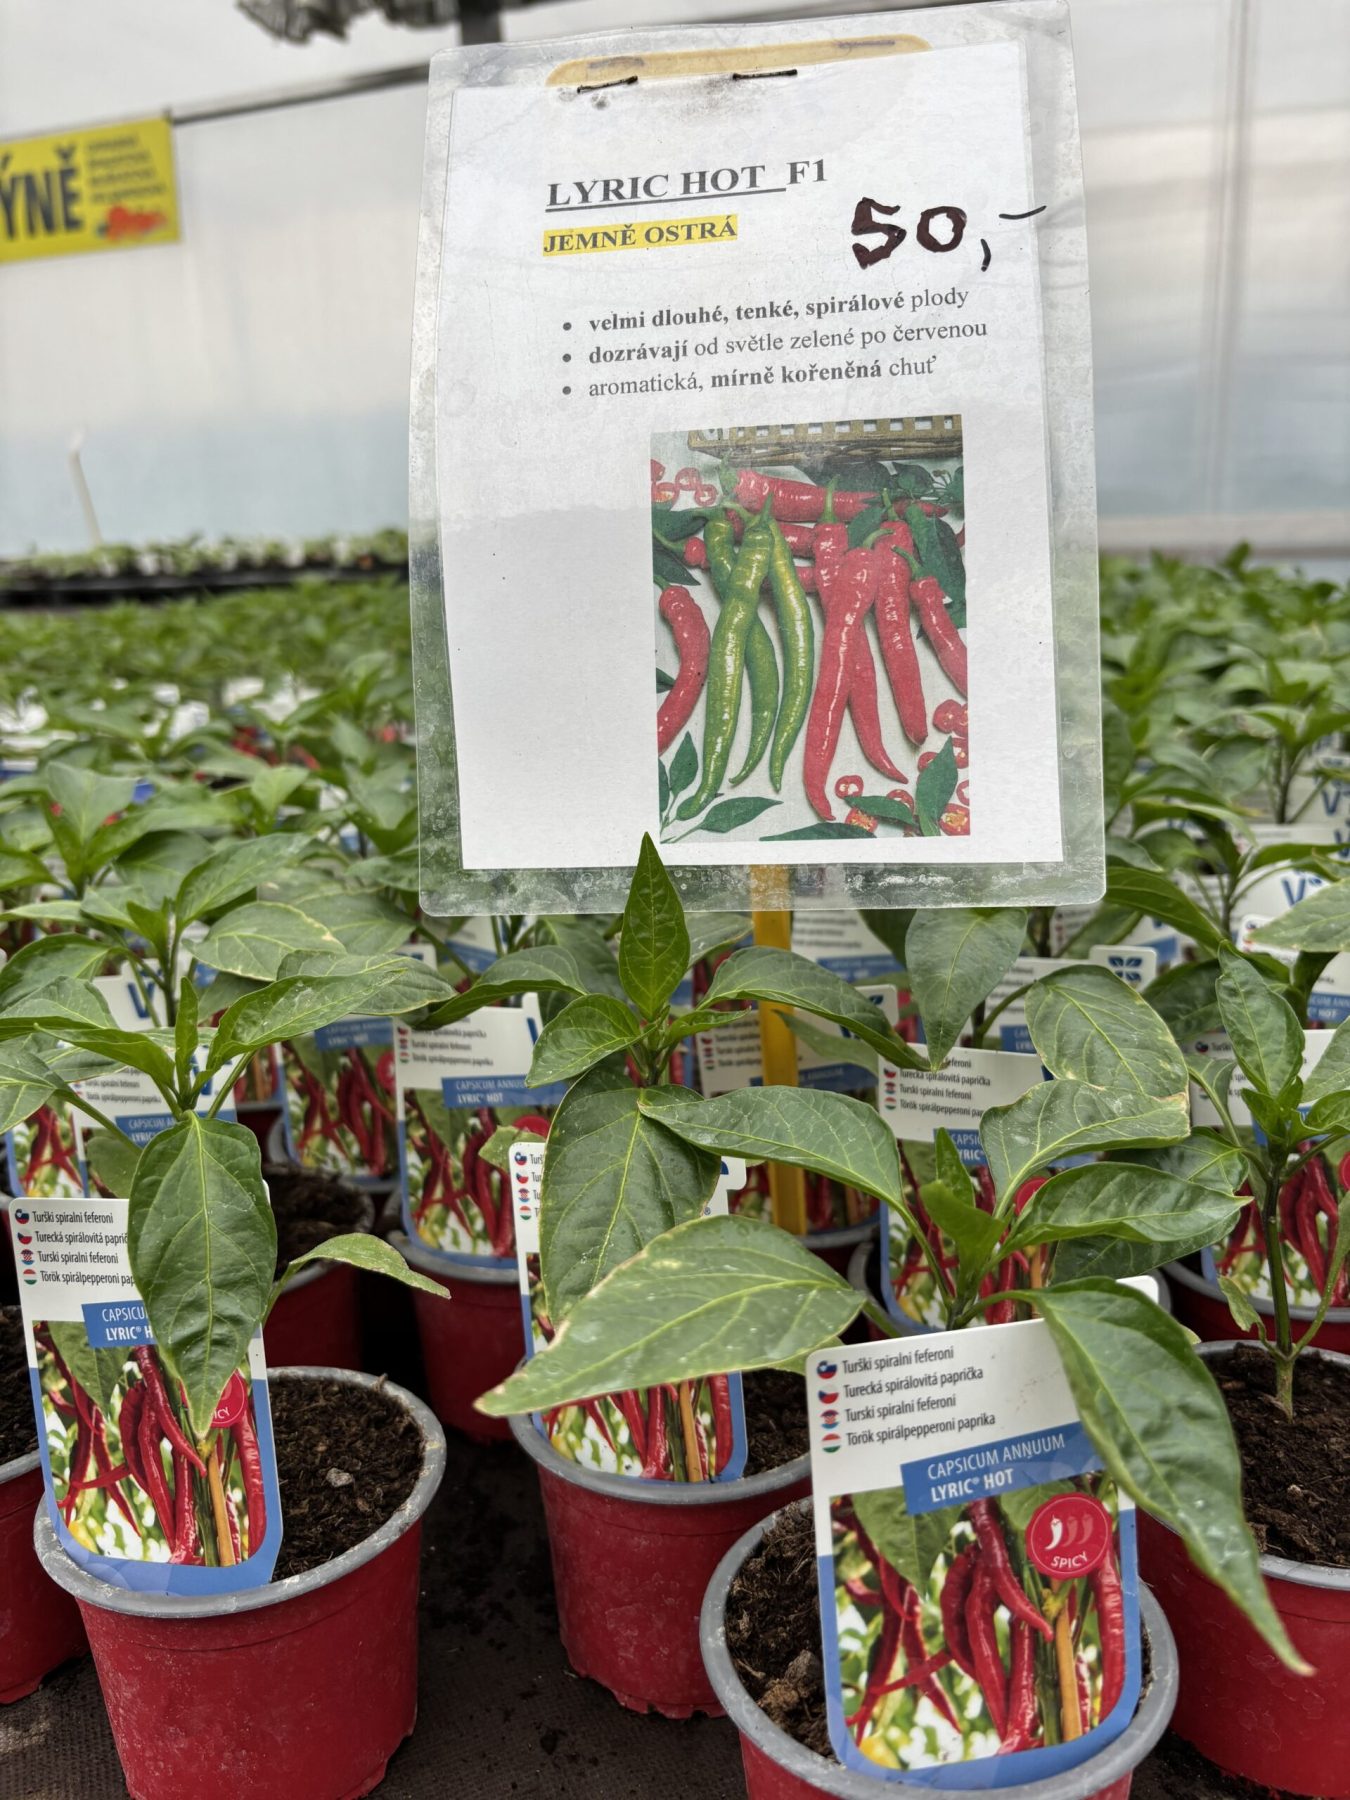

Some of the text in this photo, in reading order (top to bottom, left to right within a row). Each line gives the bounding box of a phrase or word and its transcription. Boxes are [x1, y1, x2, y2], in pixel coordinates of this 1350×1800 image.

[0, 145, 83, 240] ÝNĚ
[548, 158, 828, 207] LYRIC HOT F1
[543, 213, 738, 253] JEMNĚ OSTRÁ
[589, 287, 969, 332] velmi dlouhé, tenké, spirálové plody
[588, 322, 988, 364] dozrávají od světle zelené po červenou
[588, 355, 937, 397] aromatická, mírně kořeněná chuť
[32, 1211, 114, 1225] Turški spiralni feferoni
[35, 1231, 128, 1247] Turecká spirálovitá paprič
[37, 1250, 119, 1265] Turski spiralni feferoni
[40, 1270, 60, 1282] Török
[61, 1272, 120, 1285] spirálpepperoni
[101, 1306, 148, 1323] CAPSICU
[842, 1345, 954, 1374] Turški spiralni feferoni
[843, 1366, 984, 1398] Turecká spirálovitá paprička
[213, 1406, 231, 1419] ICY
[844, 1394, 956, 1422] Turski spiralni feferoni
[846, 1412, 996, 1446] Török spirálpepperoni paprika
[927, 1433, 1066, 1481] CAPSICUM ANNUUM
[983, 1468, 1014, 1491] HOT
[1051, 1551, 1089, 1569] SPICY
